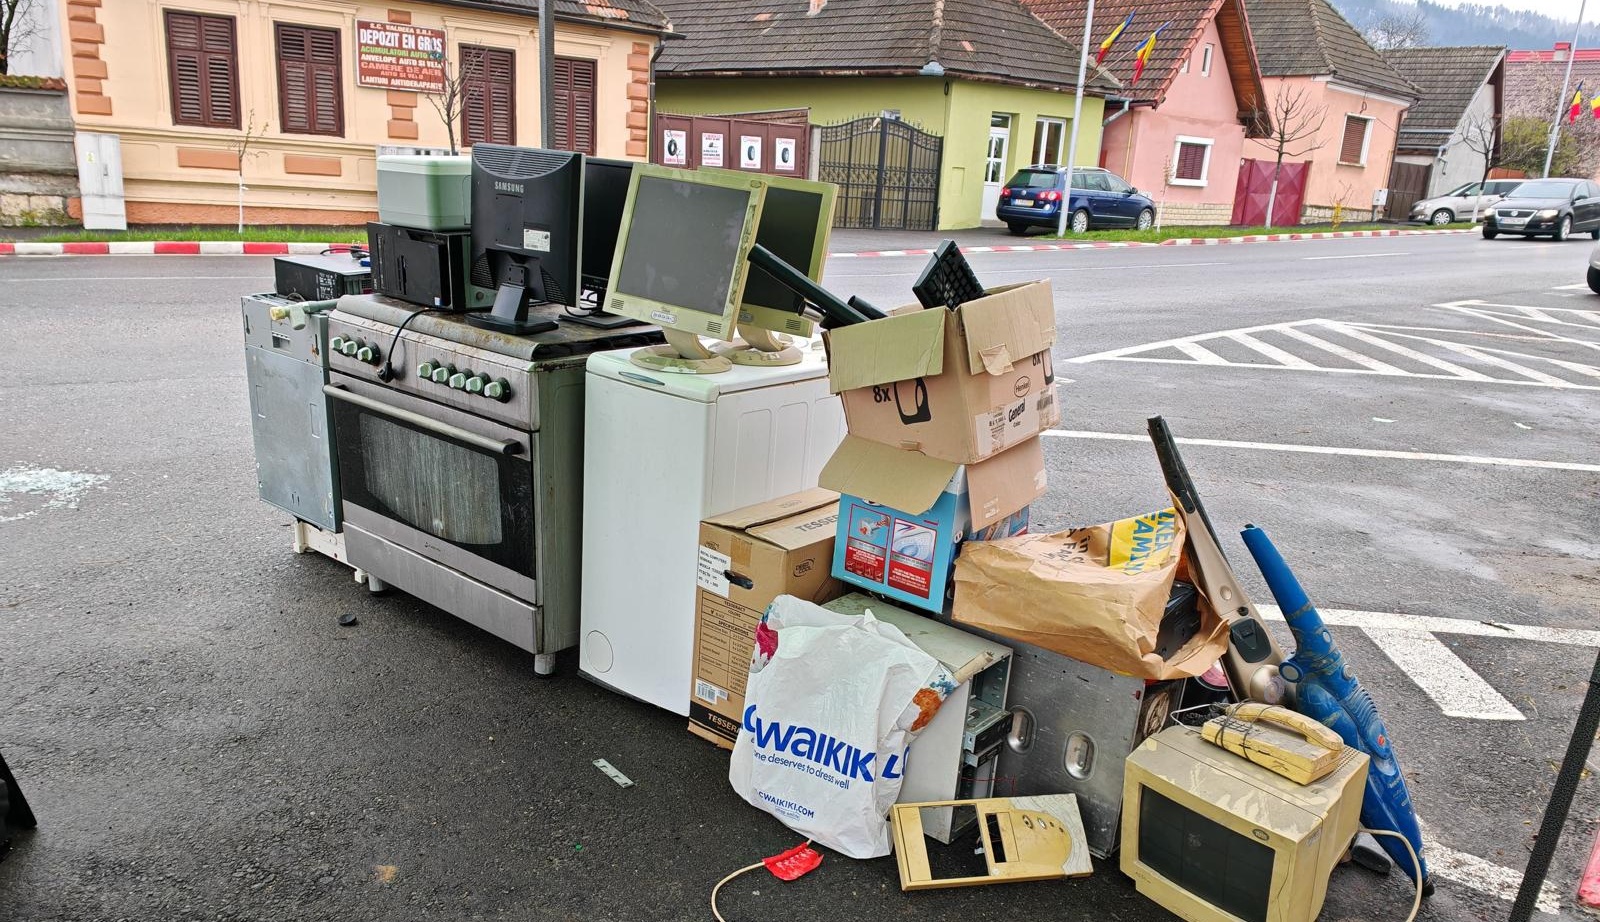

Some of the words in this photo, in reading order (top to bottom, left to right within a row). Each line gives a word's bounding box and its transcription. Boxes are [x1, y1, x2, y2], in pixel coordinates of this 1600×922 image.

[360, 29, 400, 47] DEPOZIT
[402, 34, 416, 49] EN
[418, 36, 442, 52] GROS
[360, 46, 408, 56] ACUMULATORI
[361, 54, 397, 64] ANVELOPE
[361, 62, 404, 72] CAMERE
[406, 66, 420, 74] DE
[422, 68, 442, 76] AER
[362, 76, 388, 84] LANTURI
[494, 181, 524, 193] SAMSUNG
[872, 385, 892, 403] 8x
[1008, 398, 1025, 422] General
[708, 713, 740, 733] TESSER
[768, 754, 806, 772] deserves
[806, 765, 814, 775] to
[816, 768, 834, 783] dress
[834, 777, 850, 790] well
[758, 791, 815, 819] CWAIKIKI.COM
